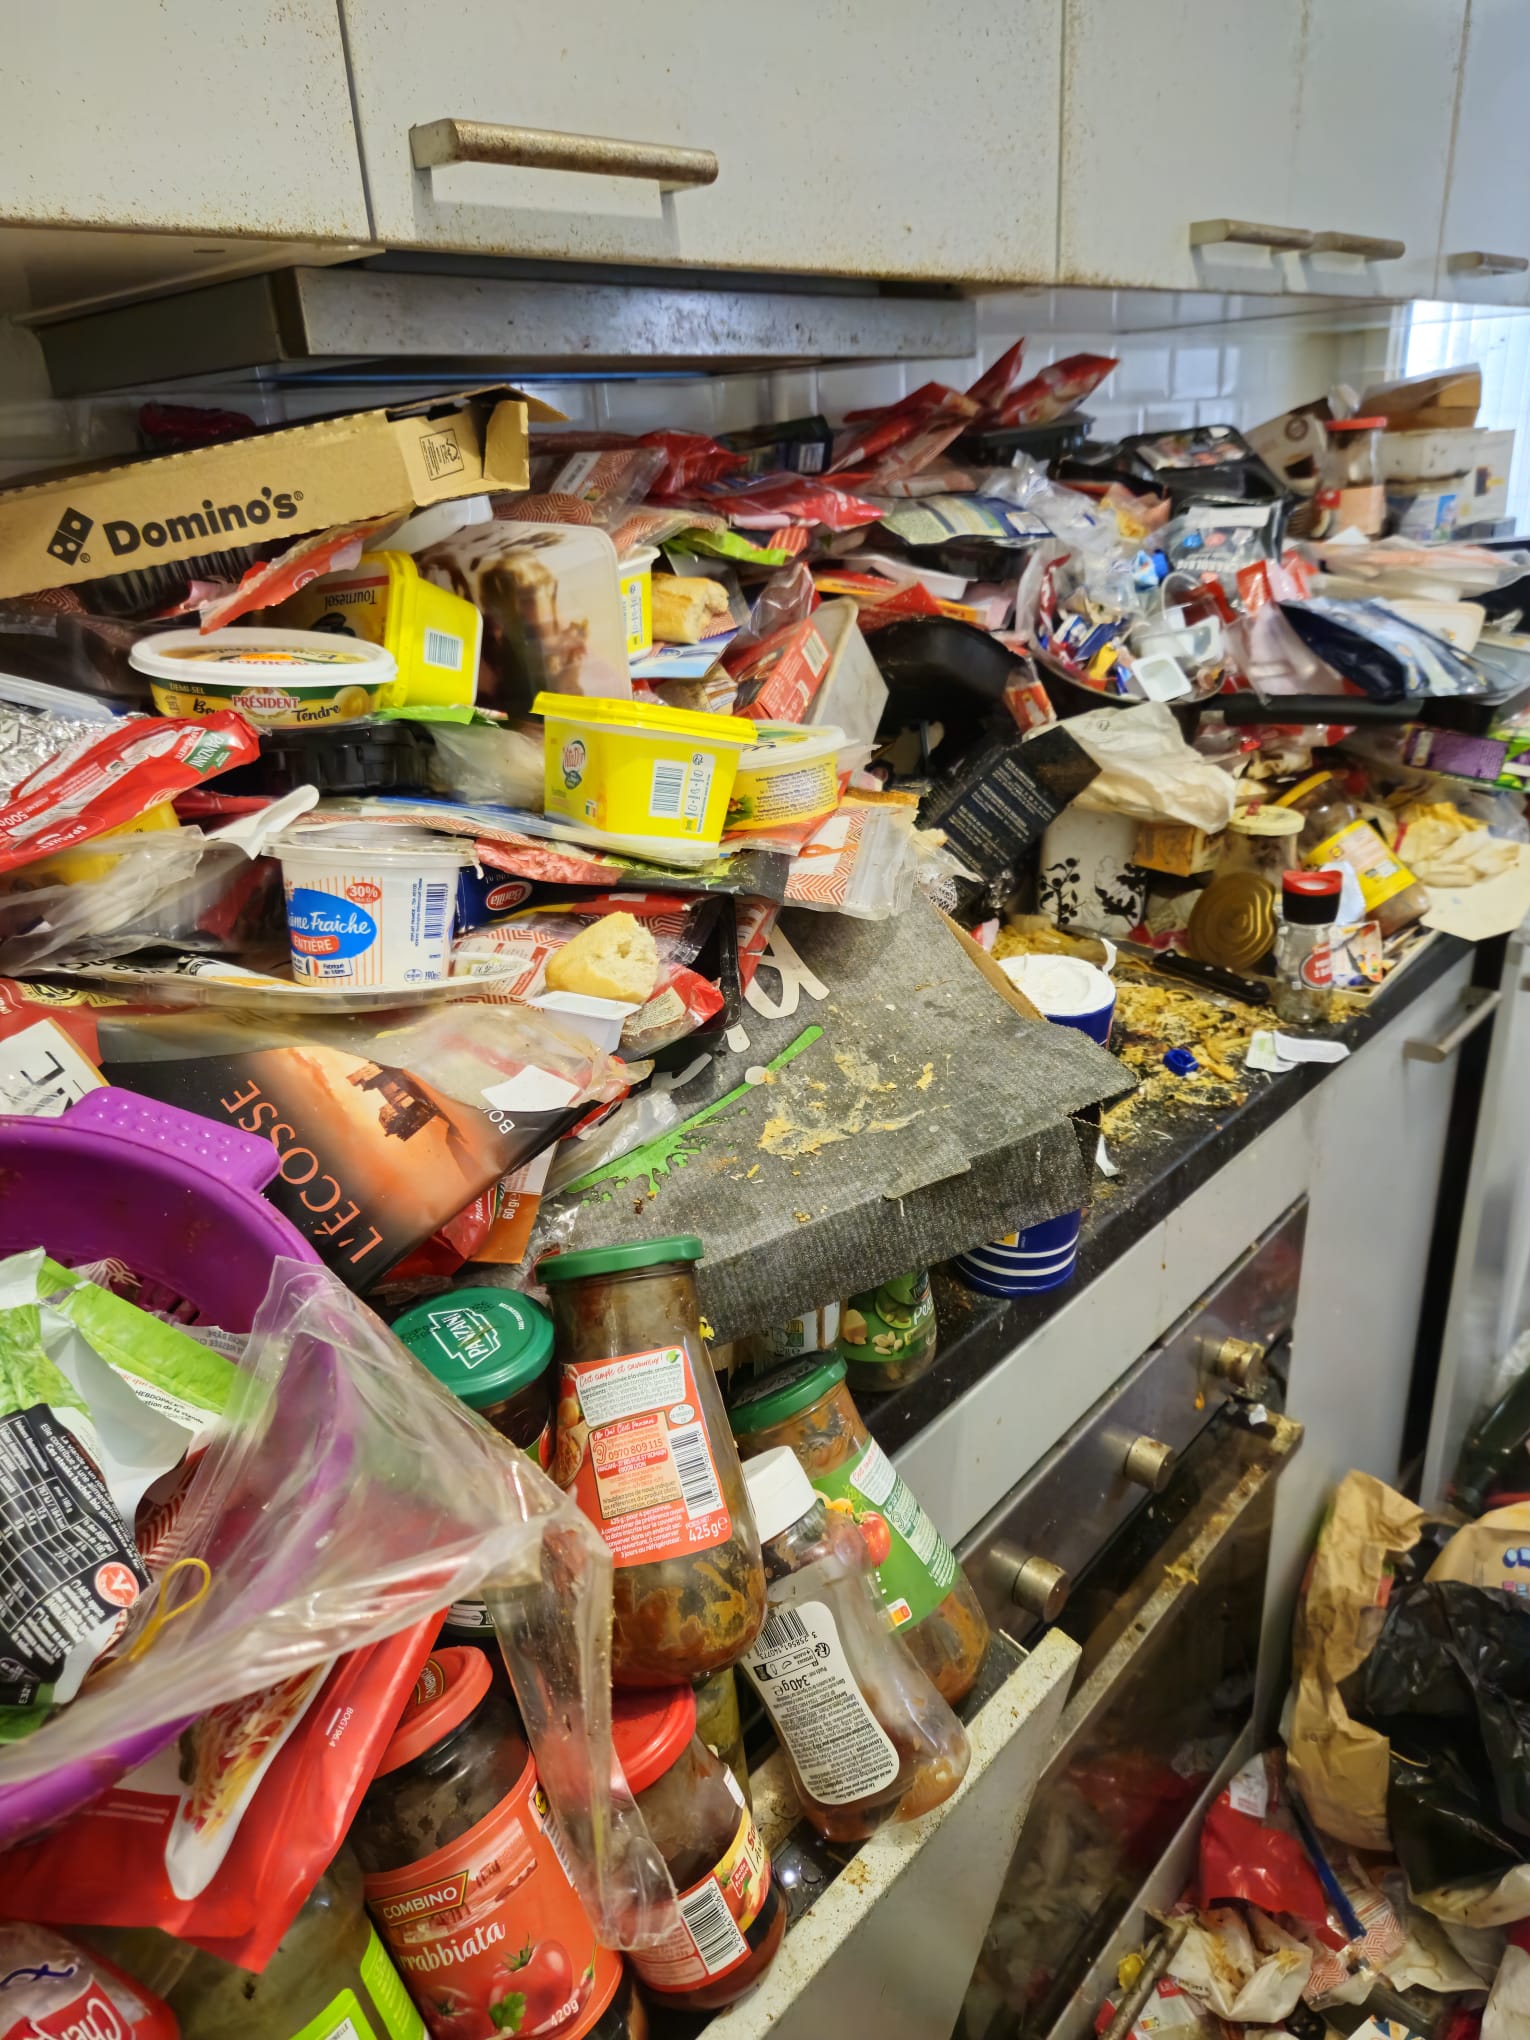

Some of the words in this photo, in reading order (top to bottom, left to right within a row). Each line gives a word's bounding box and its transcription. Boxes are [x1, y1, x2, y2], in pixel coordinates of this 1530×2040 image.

[101, 482, 298, 556] Domino's
[323, 589, 377, 610] Tournesol
[232, 691, 299, 709] PRÉSIDENT
[292, 703, 340, 721] Tendre
[185, 733, 225, 772] PANZANI
[349, 884, 379, 899] 30%
[490, 886, 522, 908] Barilla
[288, 913, 310, 929] ème
[309, 908, 372, 936] Fraîche
[293, 936, 332, 953] ENTIÈRE
[220, 1080, 384, 1264] L'ÉCOSSE
[441, 1307, 489, 1362] PANZANI
[607, 1447, 629, 1460] 0970
[629, 1442, 648, 1454] 809
[648, 1437, 663, 1448] 115
[54, 1452, 75, 1479] steaks
[88, 1496, 103, 1512] bio
[382, 1885, 458, 1920] COMBINO
[546, 1999, 582, 2027] 420g
